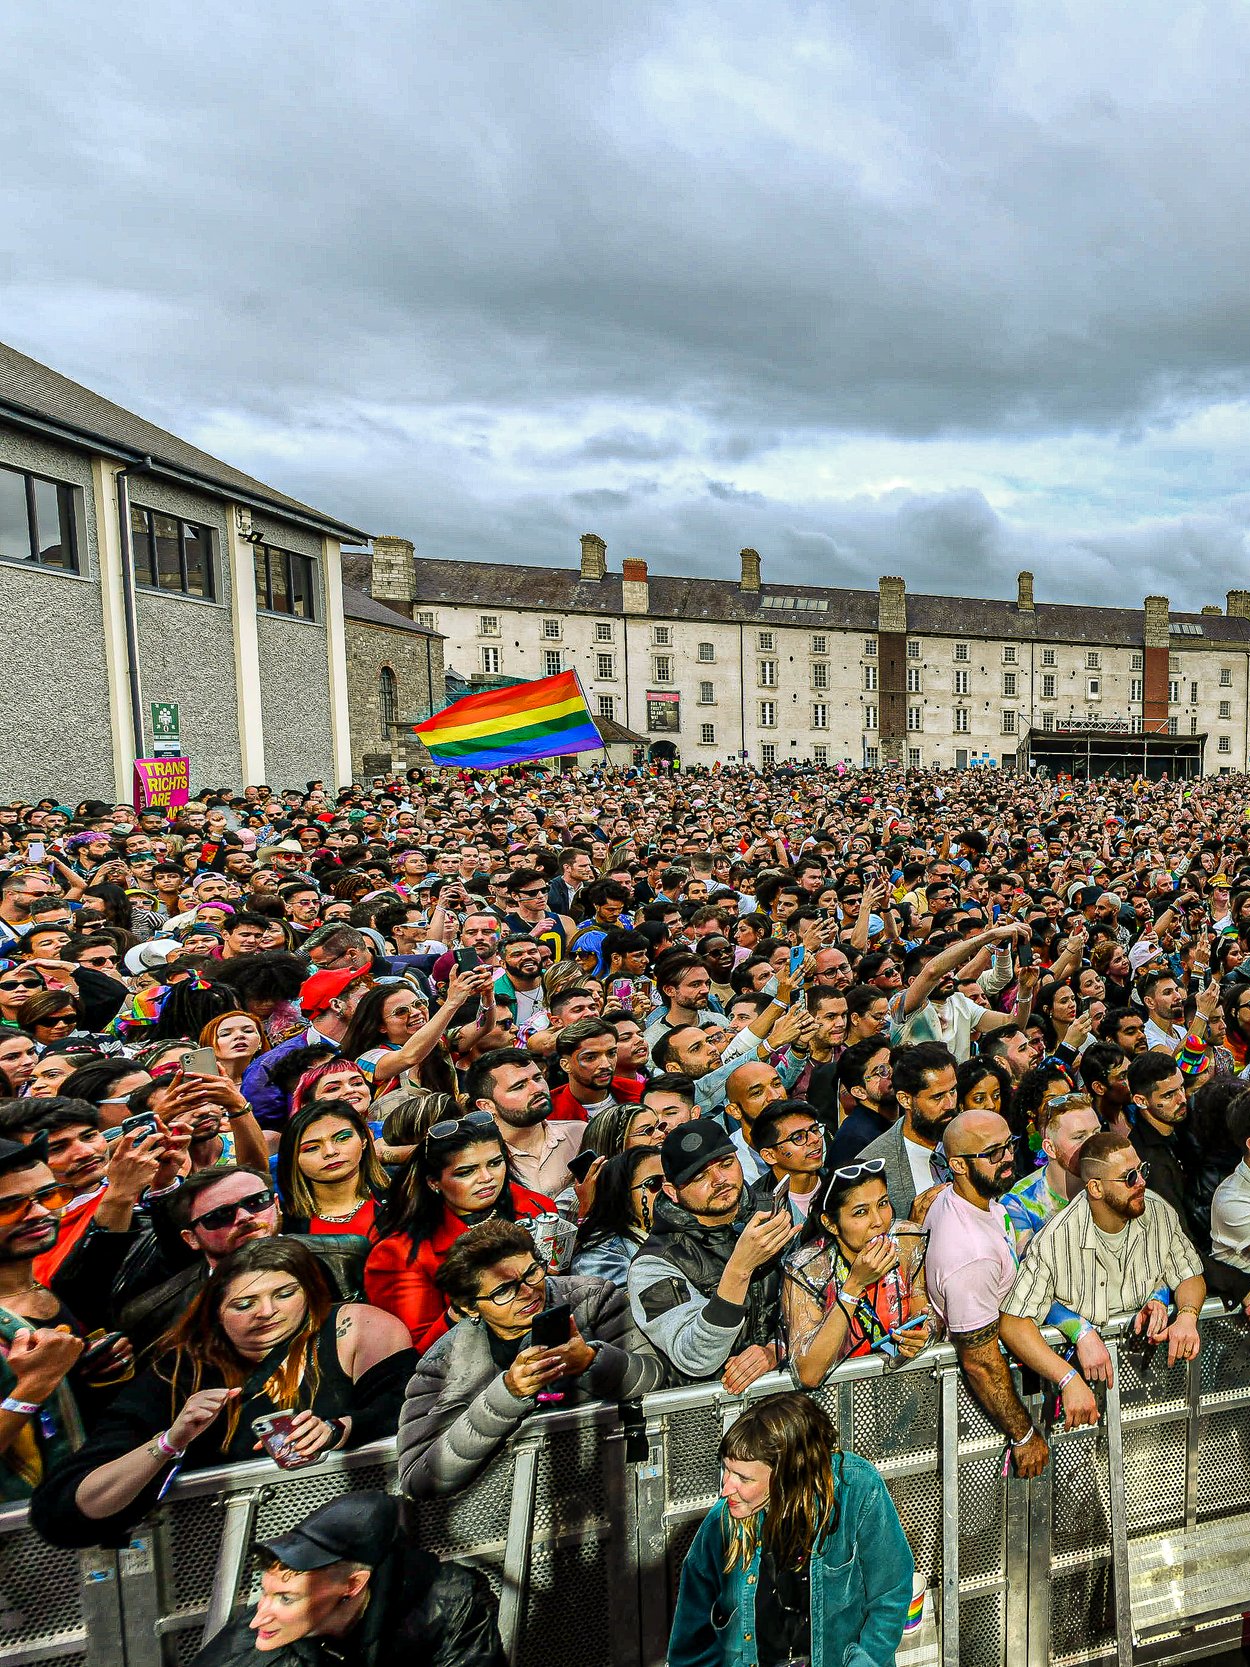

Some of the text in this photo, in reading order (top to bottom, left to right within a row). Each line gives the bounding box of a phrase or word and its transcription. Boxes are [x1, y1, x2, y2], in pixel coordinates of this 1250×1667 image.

[141, 761, 186, 776] TRANS
[147, 776, 188, 792] RIGHTS
[151, 792, 171, 806] ARE
